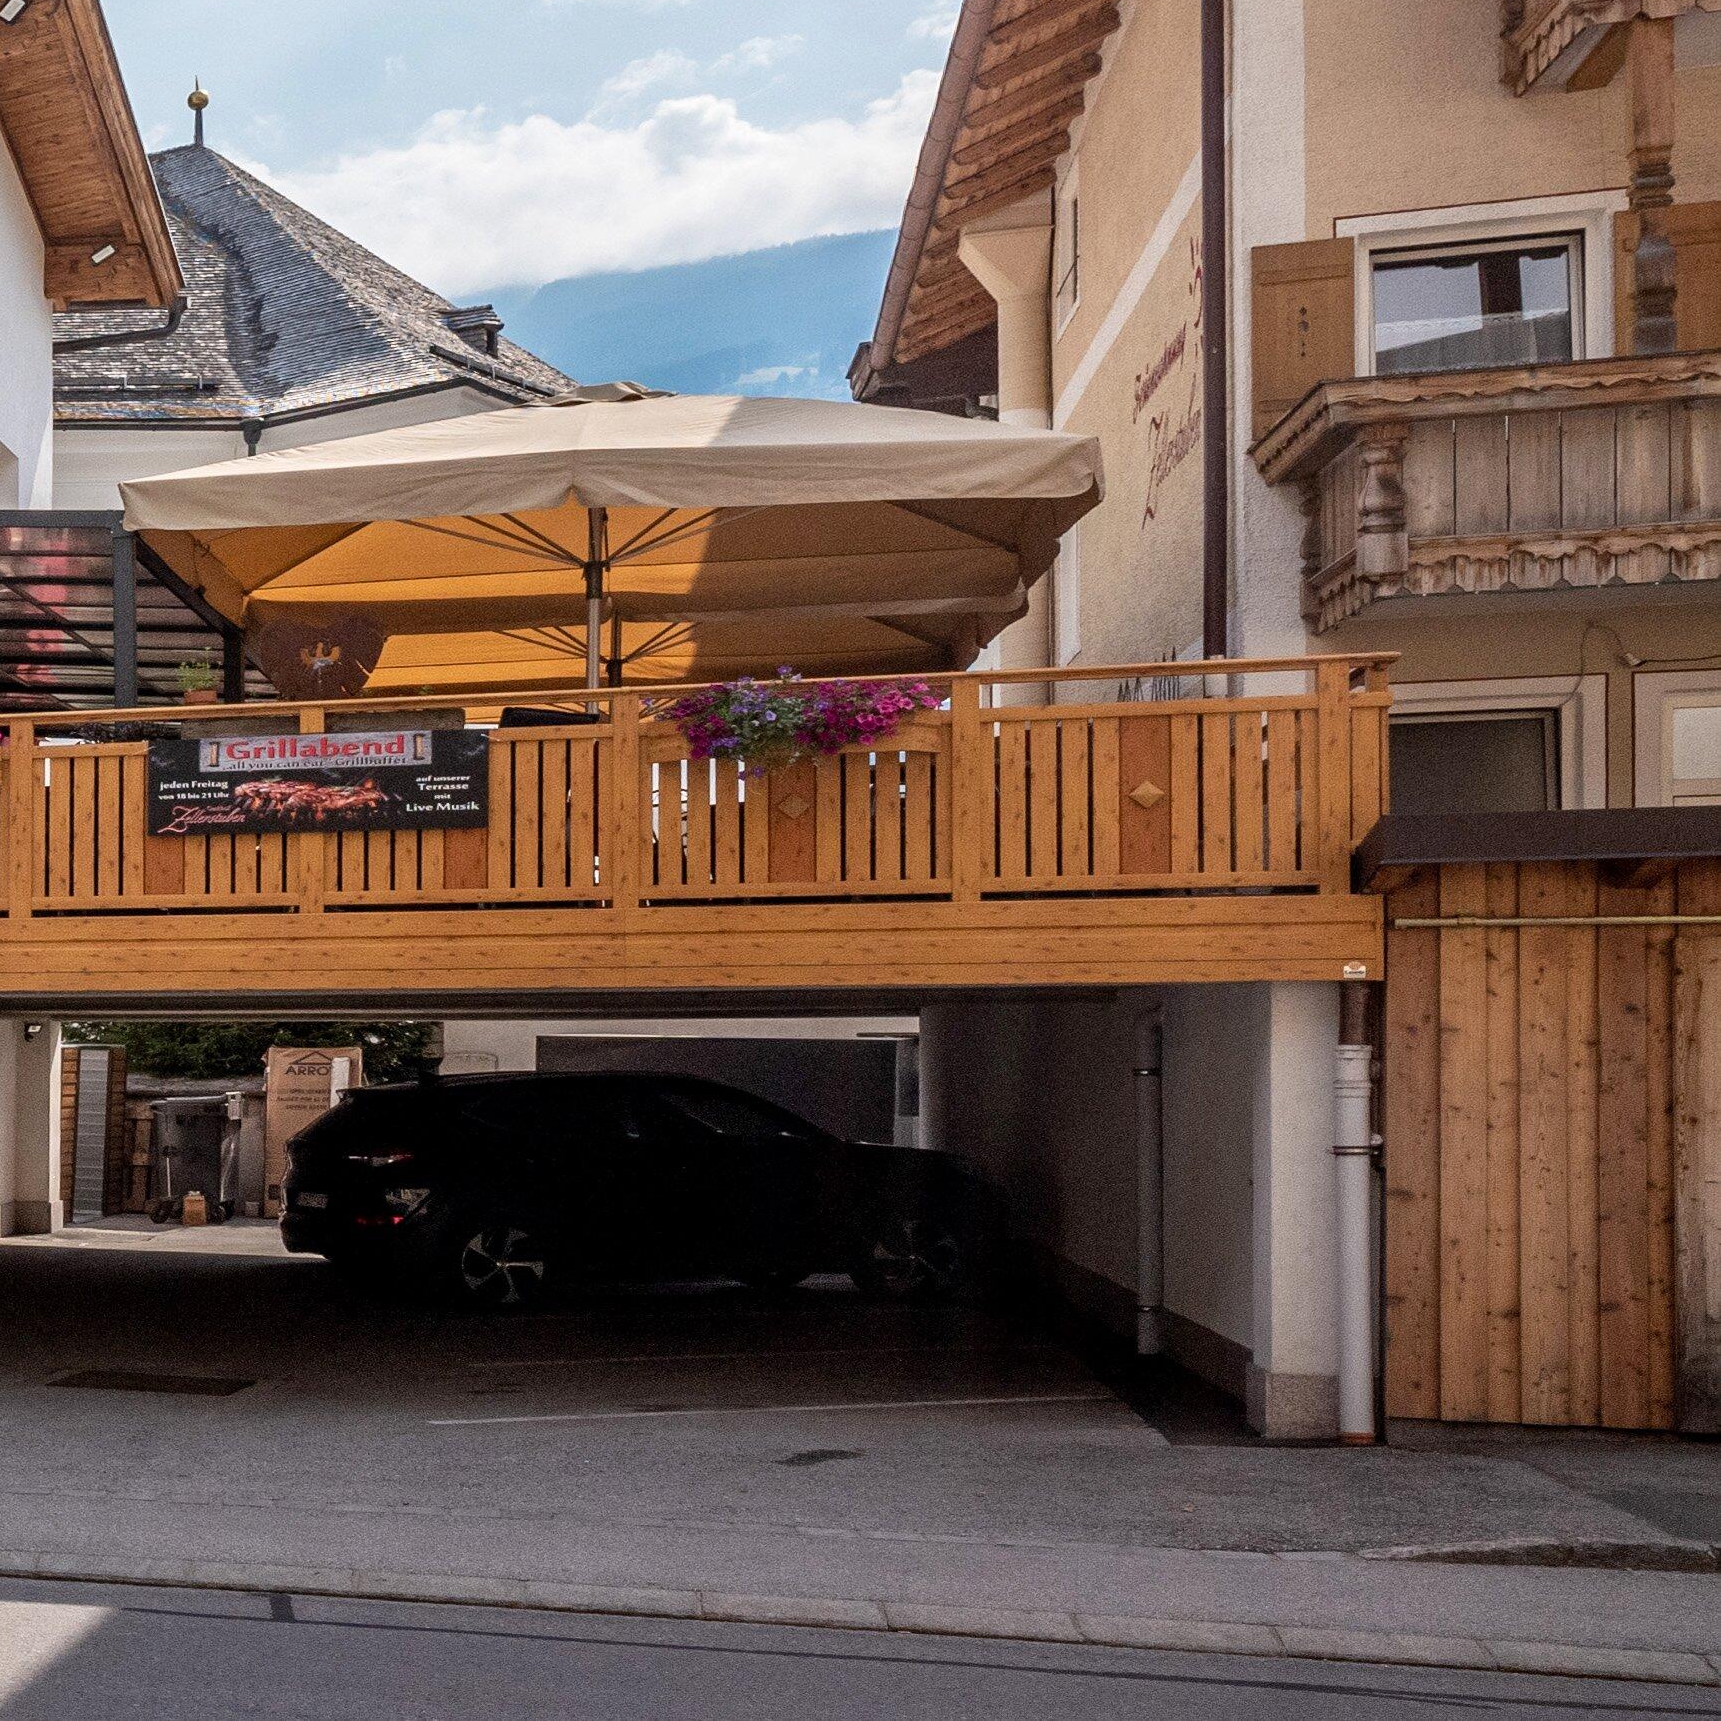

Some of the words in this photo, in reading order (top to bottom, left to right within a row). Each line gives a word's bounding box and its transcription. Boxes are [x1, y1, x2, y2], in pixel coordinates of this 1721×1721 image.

[226, 734, 405, 761] Grillabend
[248, 762, 273, 772] you
[277, 760, 300, 769] can
[336, 755, 407, 767] Grillbuffet
[160, 780, 189, 792] jeden
[191, 779, 229, 791] Freitag
[418, 783, 469, 791] Terrasse
[406, 803, 434, 812] Live
[436, 800, 480, 812] Musik
[157, 806, 246, 834] Zellerstuben
[285, 1065, 332, 1076] ARRO
